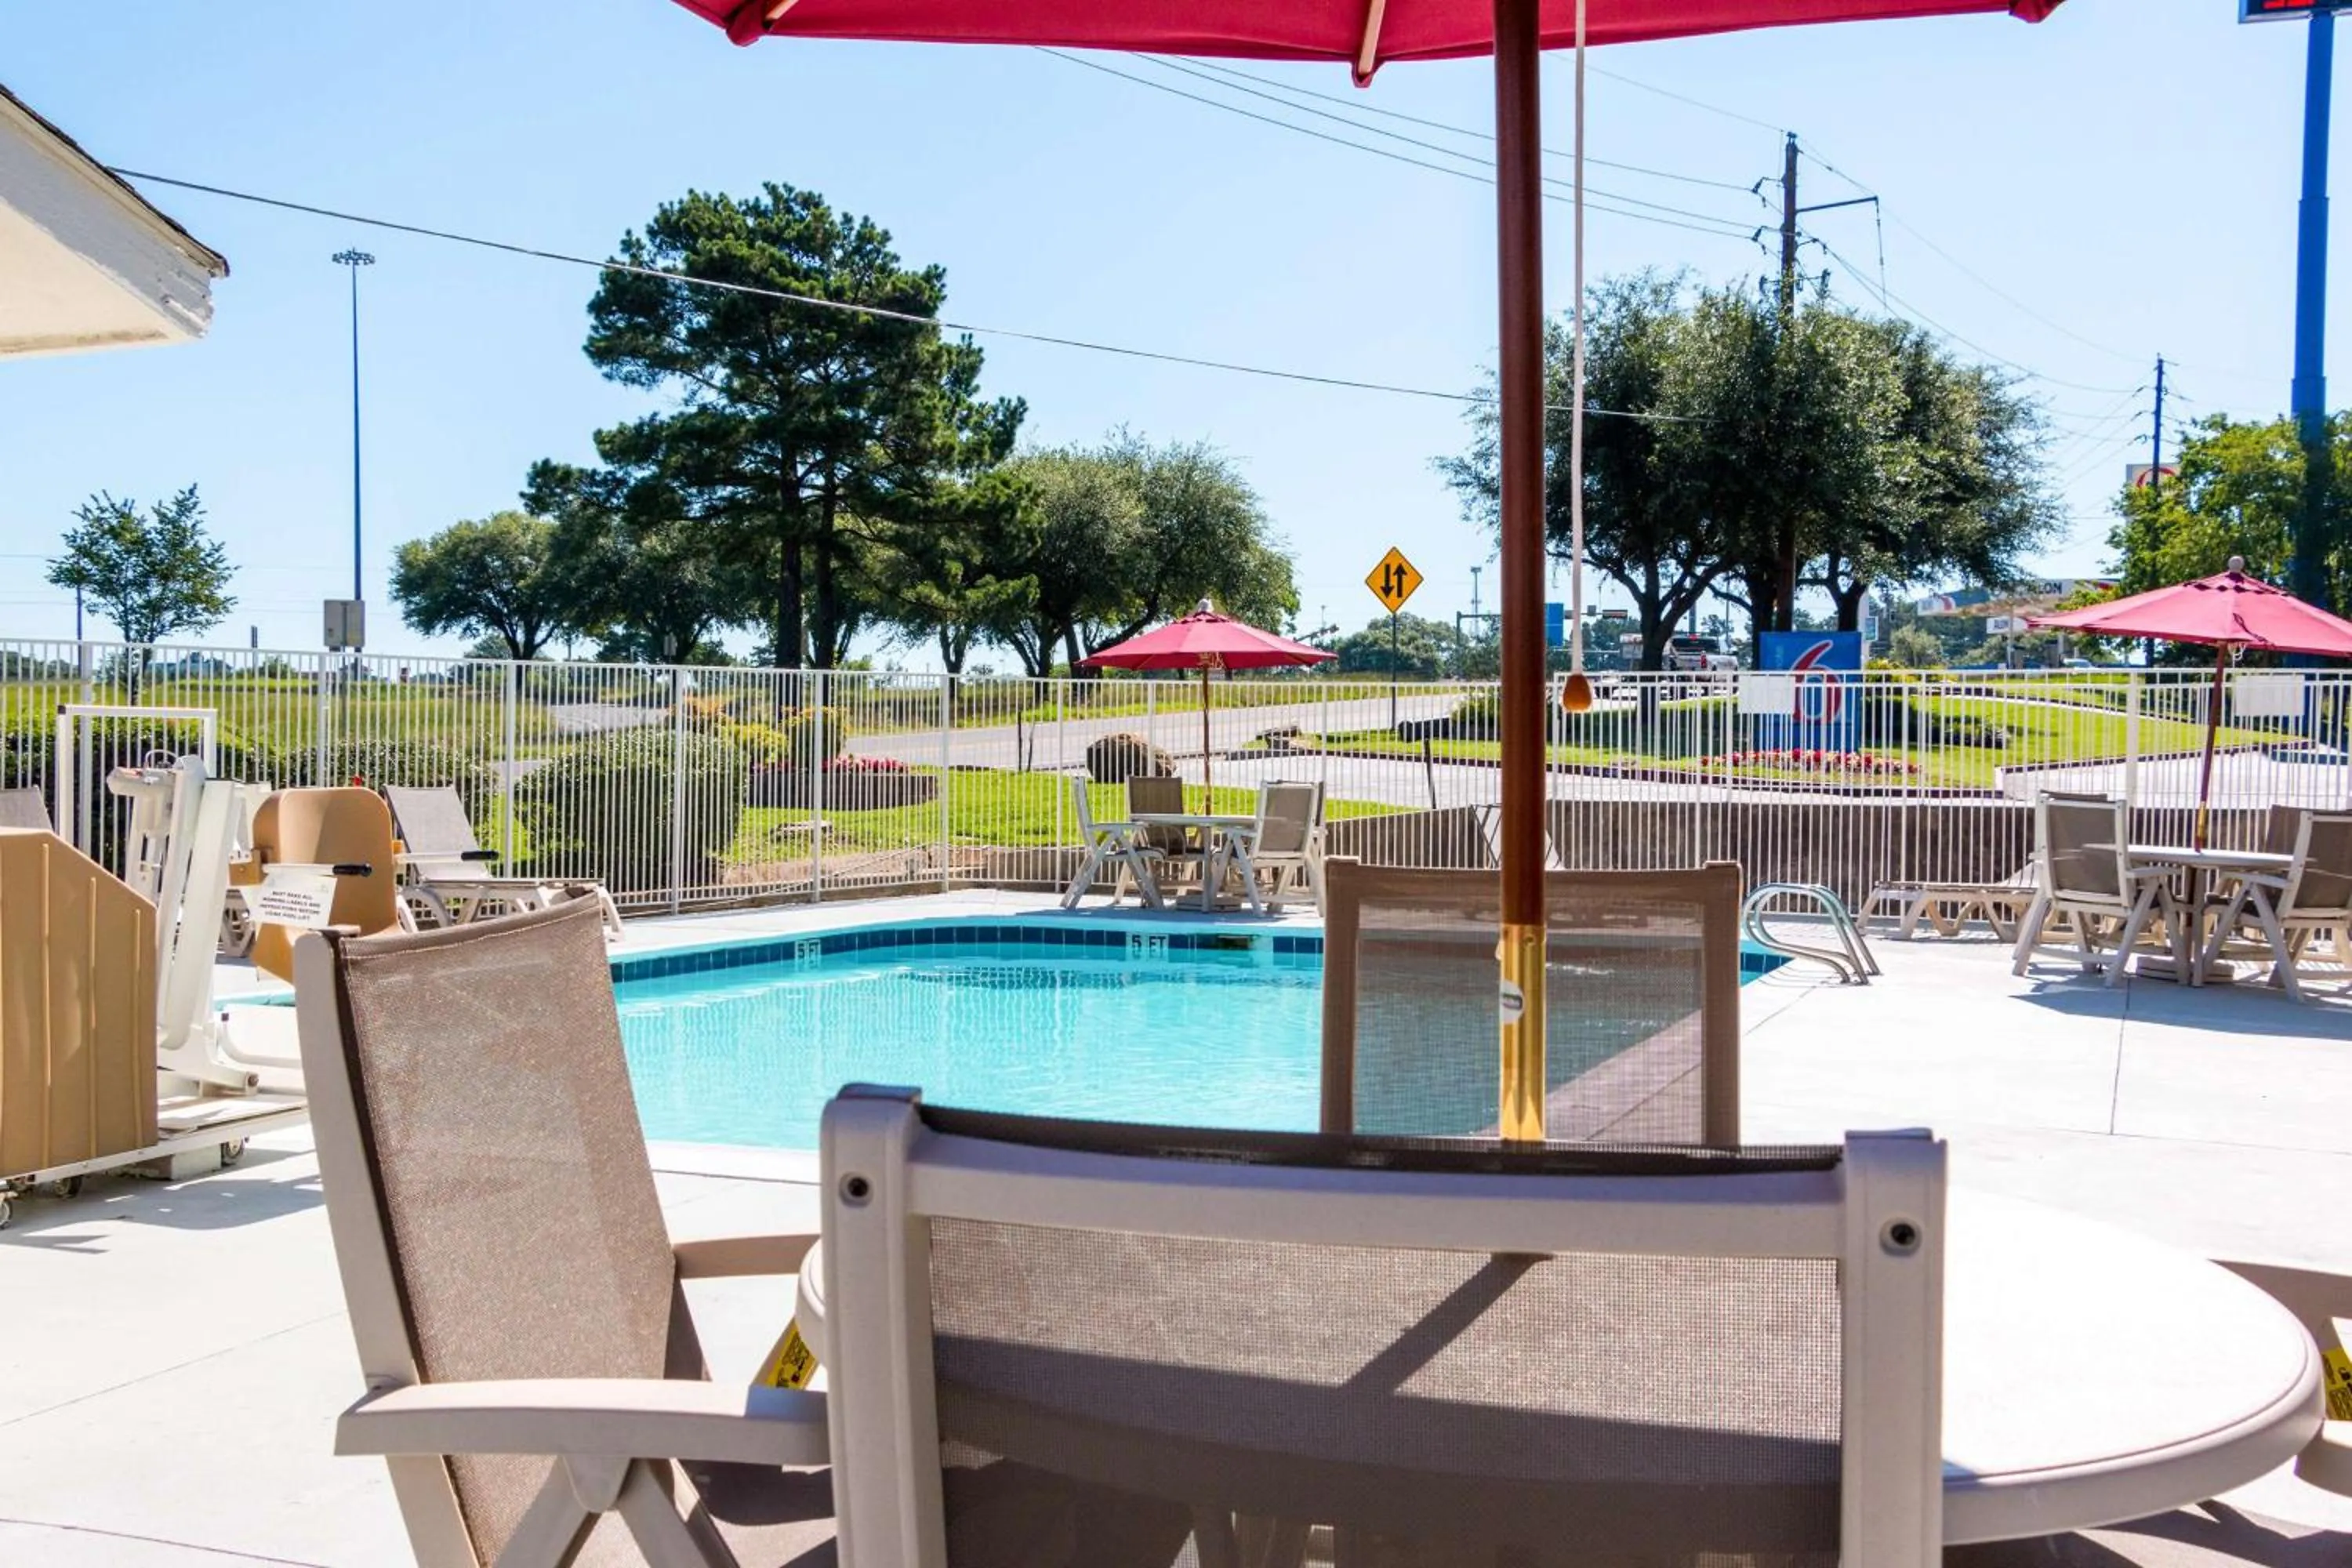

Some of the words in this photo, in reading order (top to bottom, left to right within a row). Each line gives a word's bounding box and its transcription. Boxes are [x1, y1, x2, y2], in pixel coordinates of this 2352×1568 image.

[1790, 639, 1842, 724] 6
[1132, 934, 1142, 948] 5
[1149, 935, 1166, 949] FT
[798, 943, 804, 959] 5
[809, 942, 818, 958] FT
